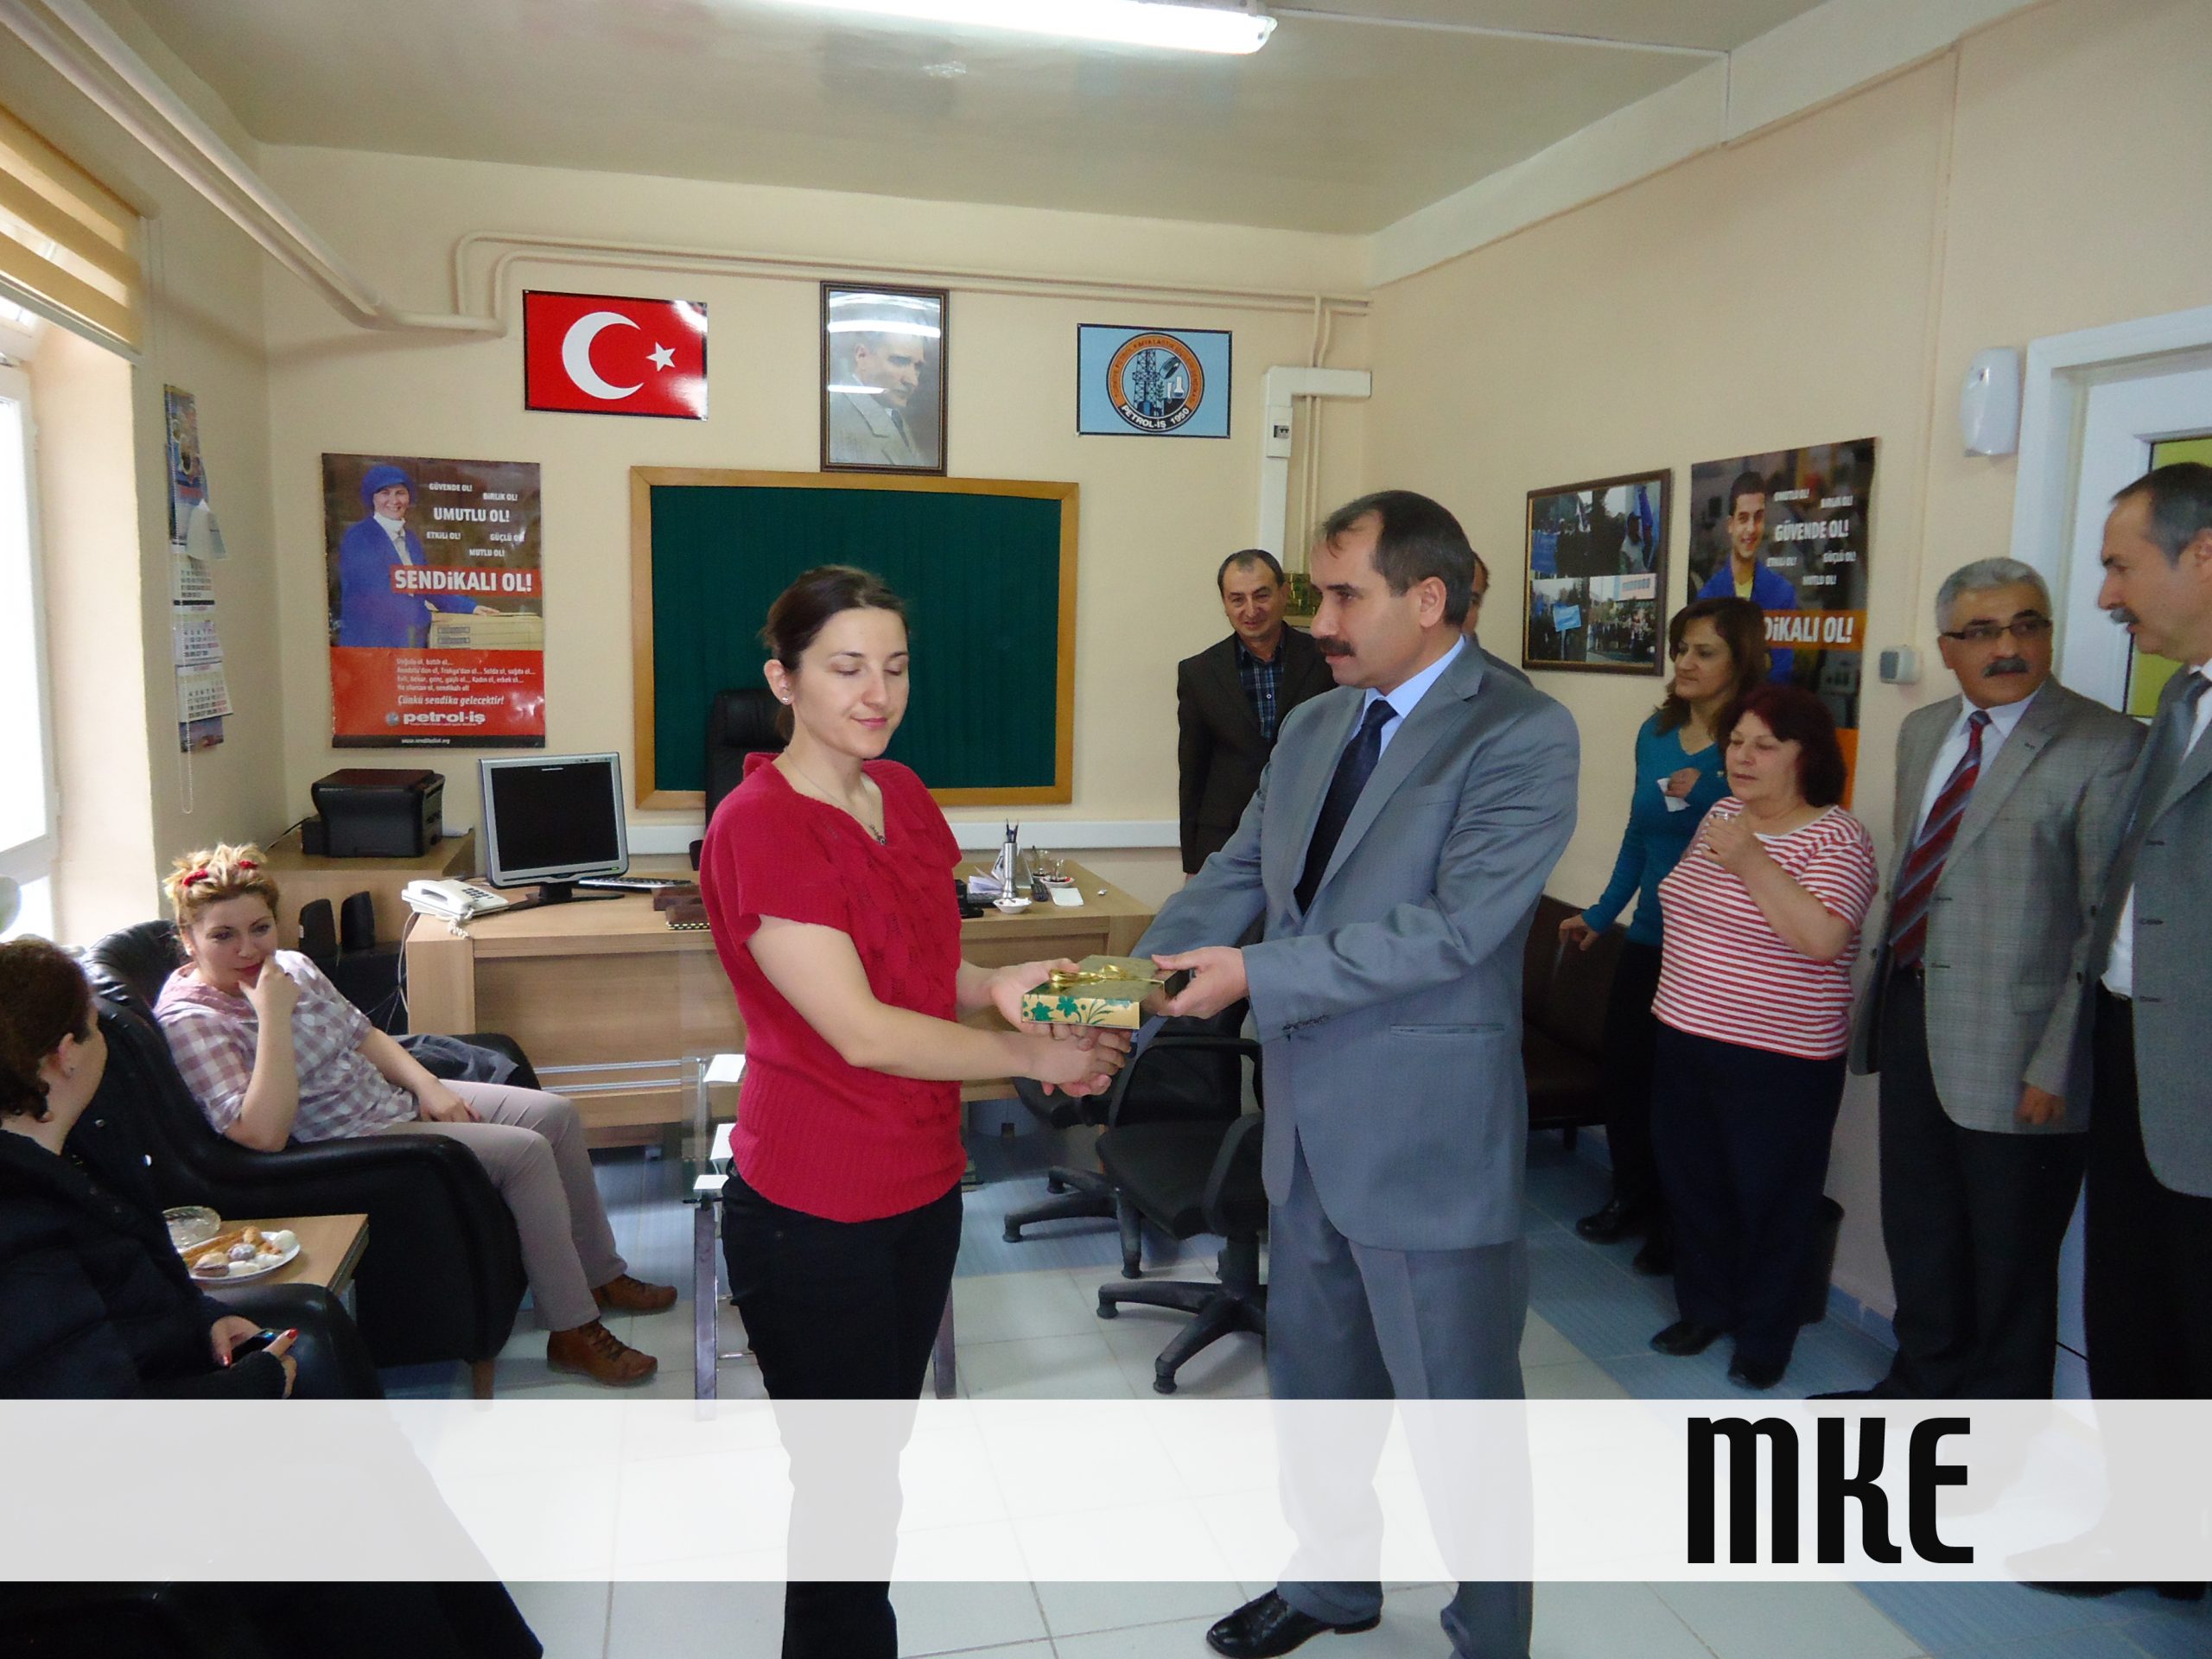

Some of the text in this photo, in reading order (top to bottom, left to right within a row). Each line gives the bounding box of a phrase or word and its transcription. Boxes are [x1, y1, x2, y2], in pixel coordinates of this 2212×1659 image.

[1170, 407, 1190, 424] 1950
[461, 484, 473, 493] OL!
[433, 507, 510, 523] UMUTLU OL!
[1775, 518, 1849, 543] GÜVENDE OL!
[502, 572, 532, 593] OL!
[1823, 616, 1853, 644] OL!
[424, 696, 458, 705] sendika
[460, 695, 505, 707] gelecektir!
